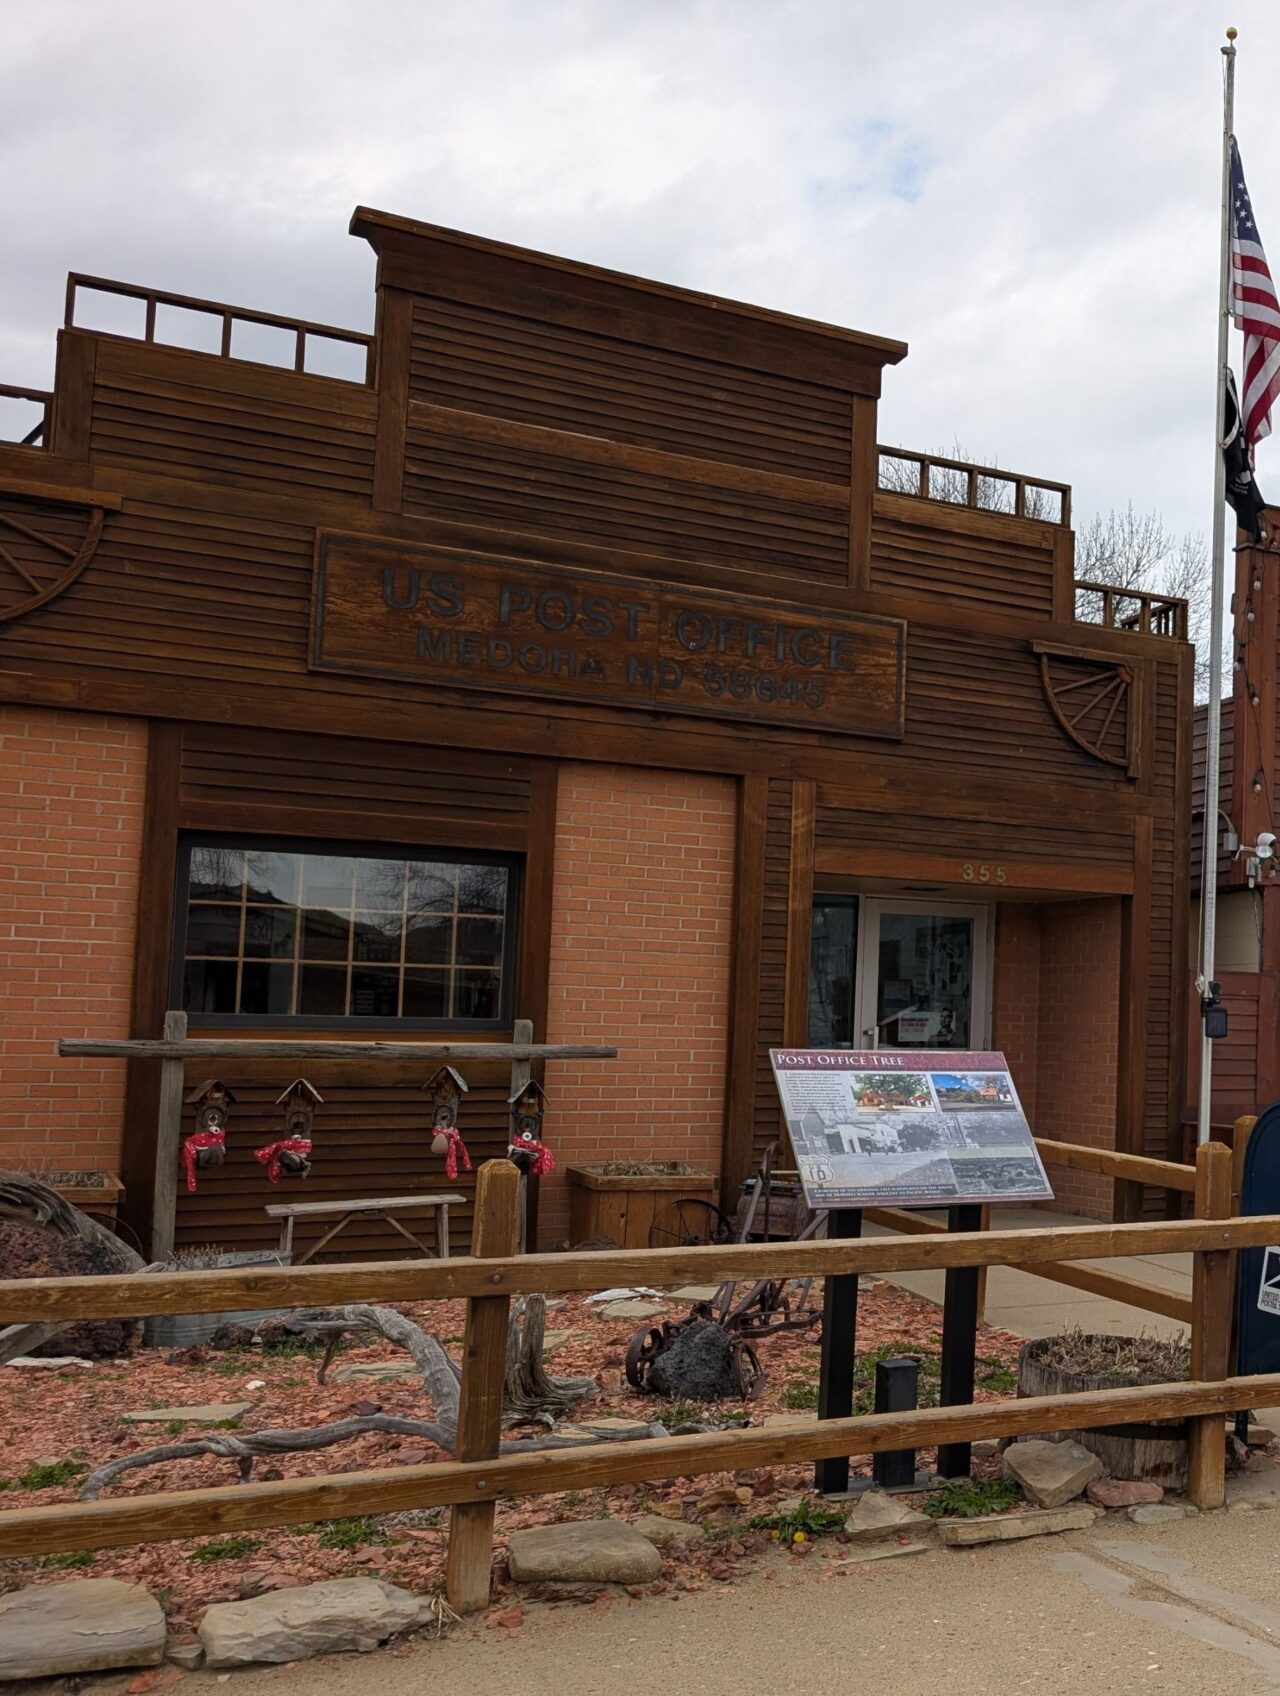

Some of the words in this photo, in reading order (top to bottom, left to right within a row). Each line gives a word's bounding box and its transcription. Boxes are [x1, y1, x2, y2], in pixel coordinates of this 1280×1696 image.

[382, 566, 466, 618] US
[500, 583, 649, 642] POST
[676, 608, 856, 672] OFFICE
[418, 628, 604, 680] MEDORA
[627, 656, 684, 691] ND
[705, 666, 826, 710] 58645
[962, 864, 1006, 883] 355
[777, 1054, 813, 1065] POST
[817, 1054, 867, 1066] OFFICE
[870, 1055, 905, 1067] TREE
[1262, 1289, 1279, 1299] UNITED
[1260, 1298, 1278, 1309] POSTAL
